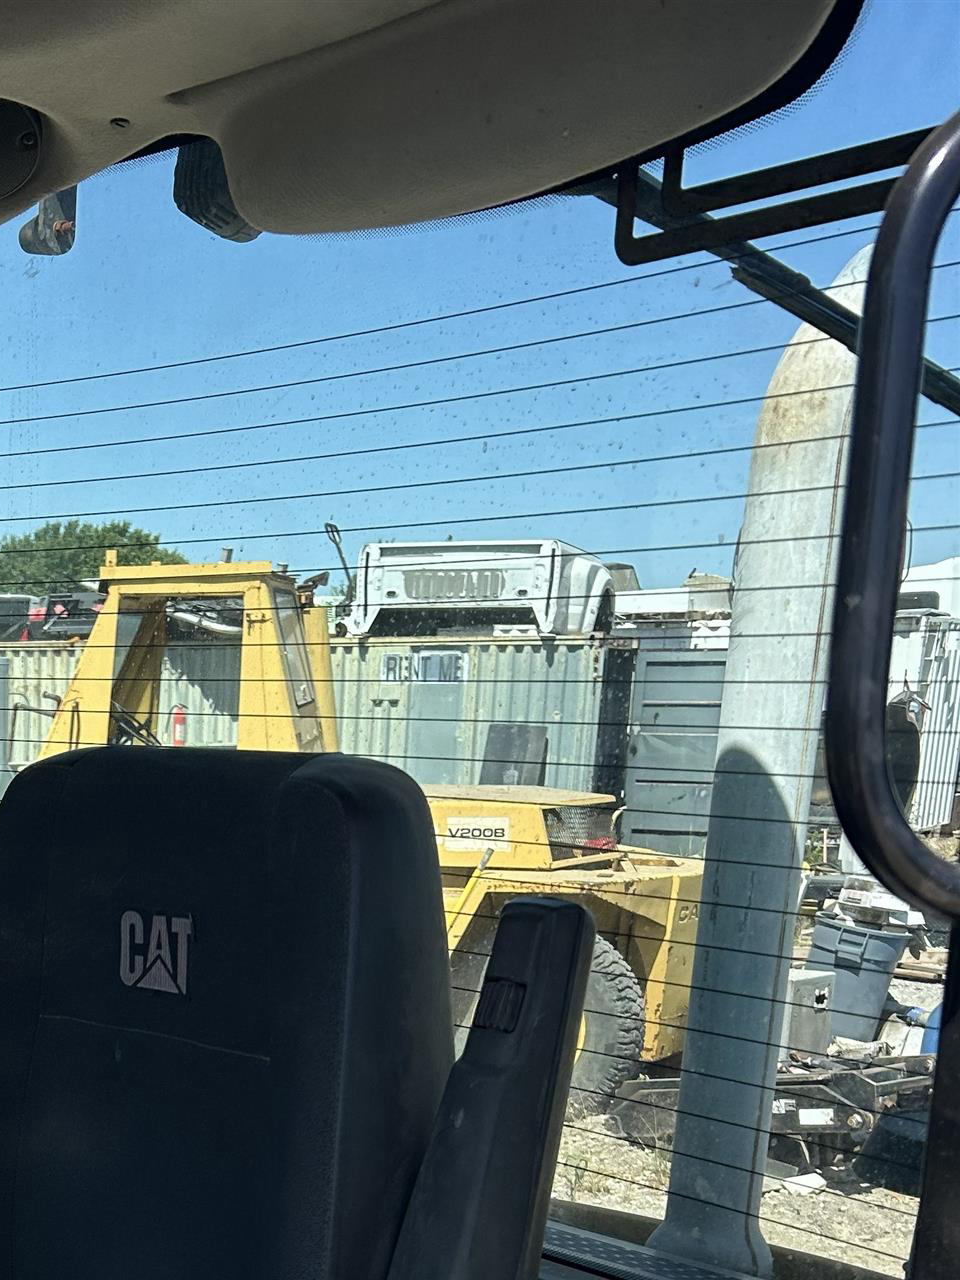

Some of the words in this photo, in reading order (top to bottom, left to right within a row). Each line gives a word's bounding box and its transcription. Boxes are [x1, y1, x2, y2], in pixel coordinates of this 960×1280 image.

[386, 655, 432, 682] RENT
[438, 655, 462, 682] ME
[448, 828, 506, 838] V200B
[679, 904, 699, 923] CA
[120, 910, 192, 995] CAT
